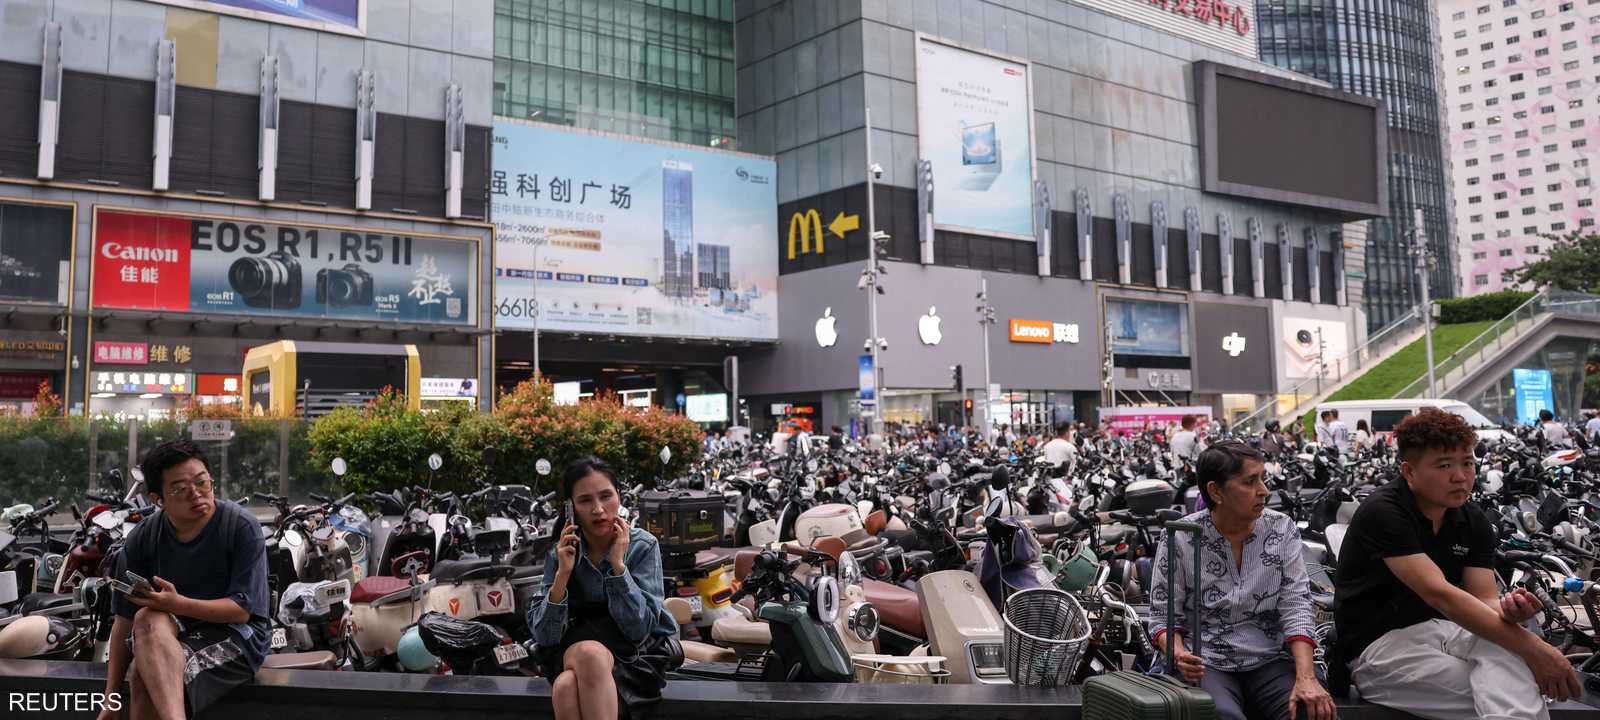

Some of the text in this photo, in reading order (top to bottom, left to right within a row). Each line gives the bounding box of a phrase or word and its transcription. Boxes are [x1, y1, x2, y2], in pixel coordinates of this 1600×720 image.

[1149, 0, 1250, 37] 交易中心
[192, 221, 266, 254] EOS
[101, 242, 179, 263] Canon
[120, 265, 159, 284] 佳能
[222, 291, 234, 300] R1
[1014, 322, 1050, 337] Lenovo
[150, 344, 192, 364] 维修
